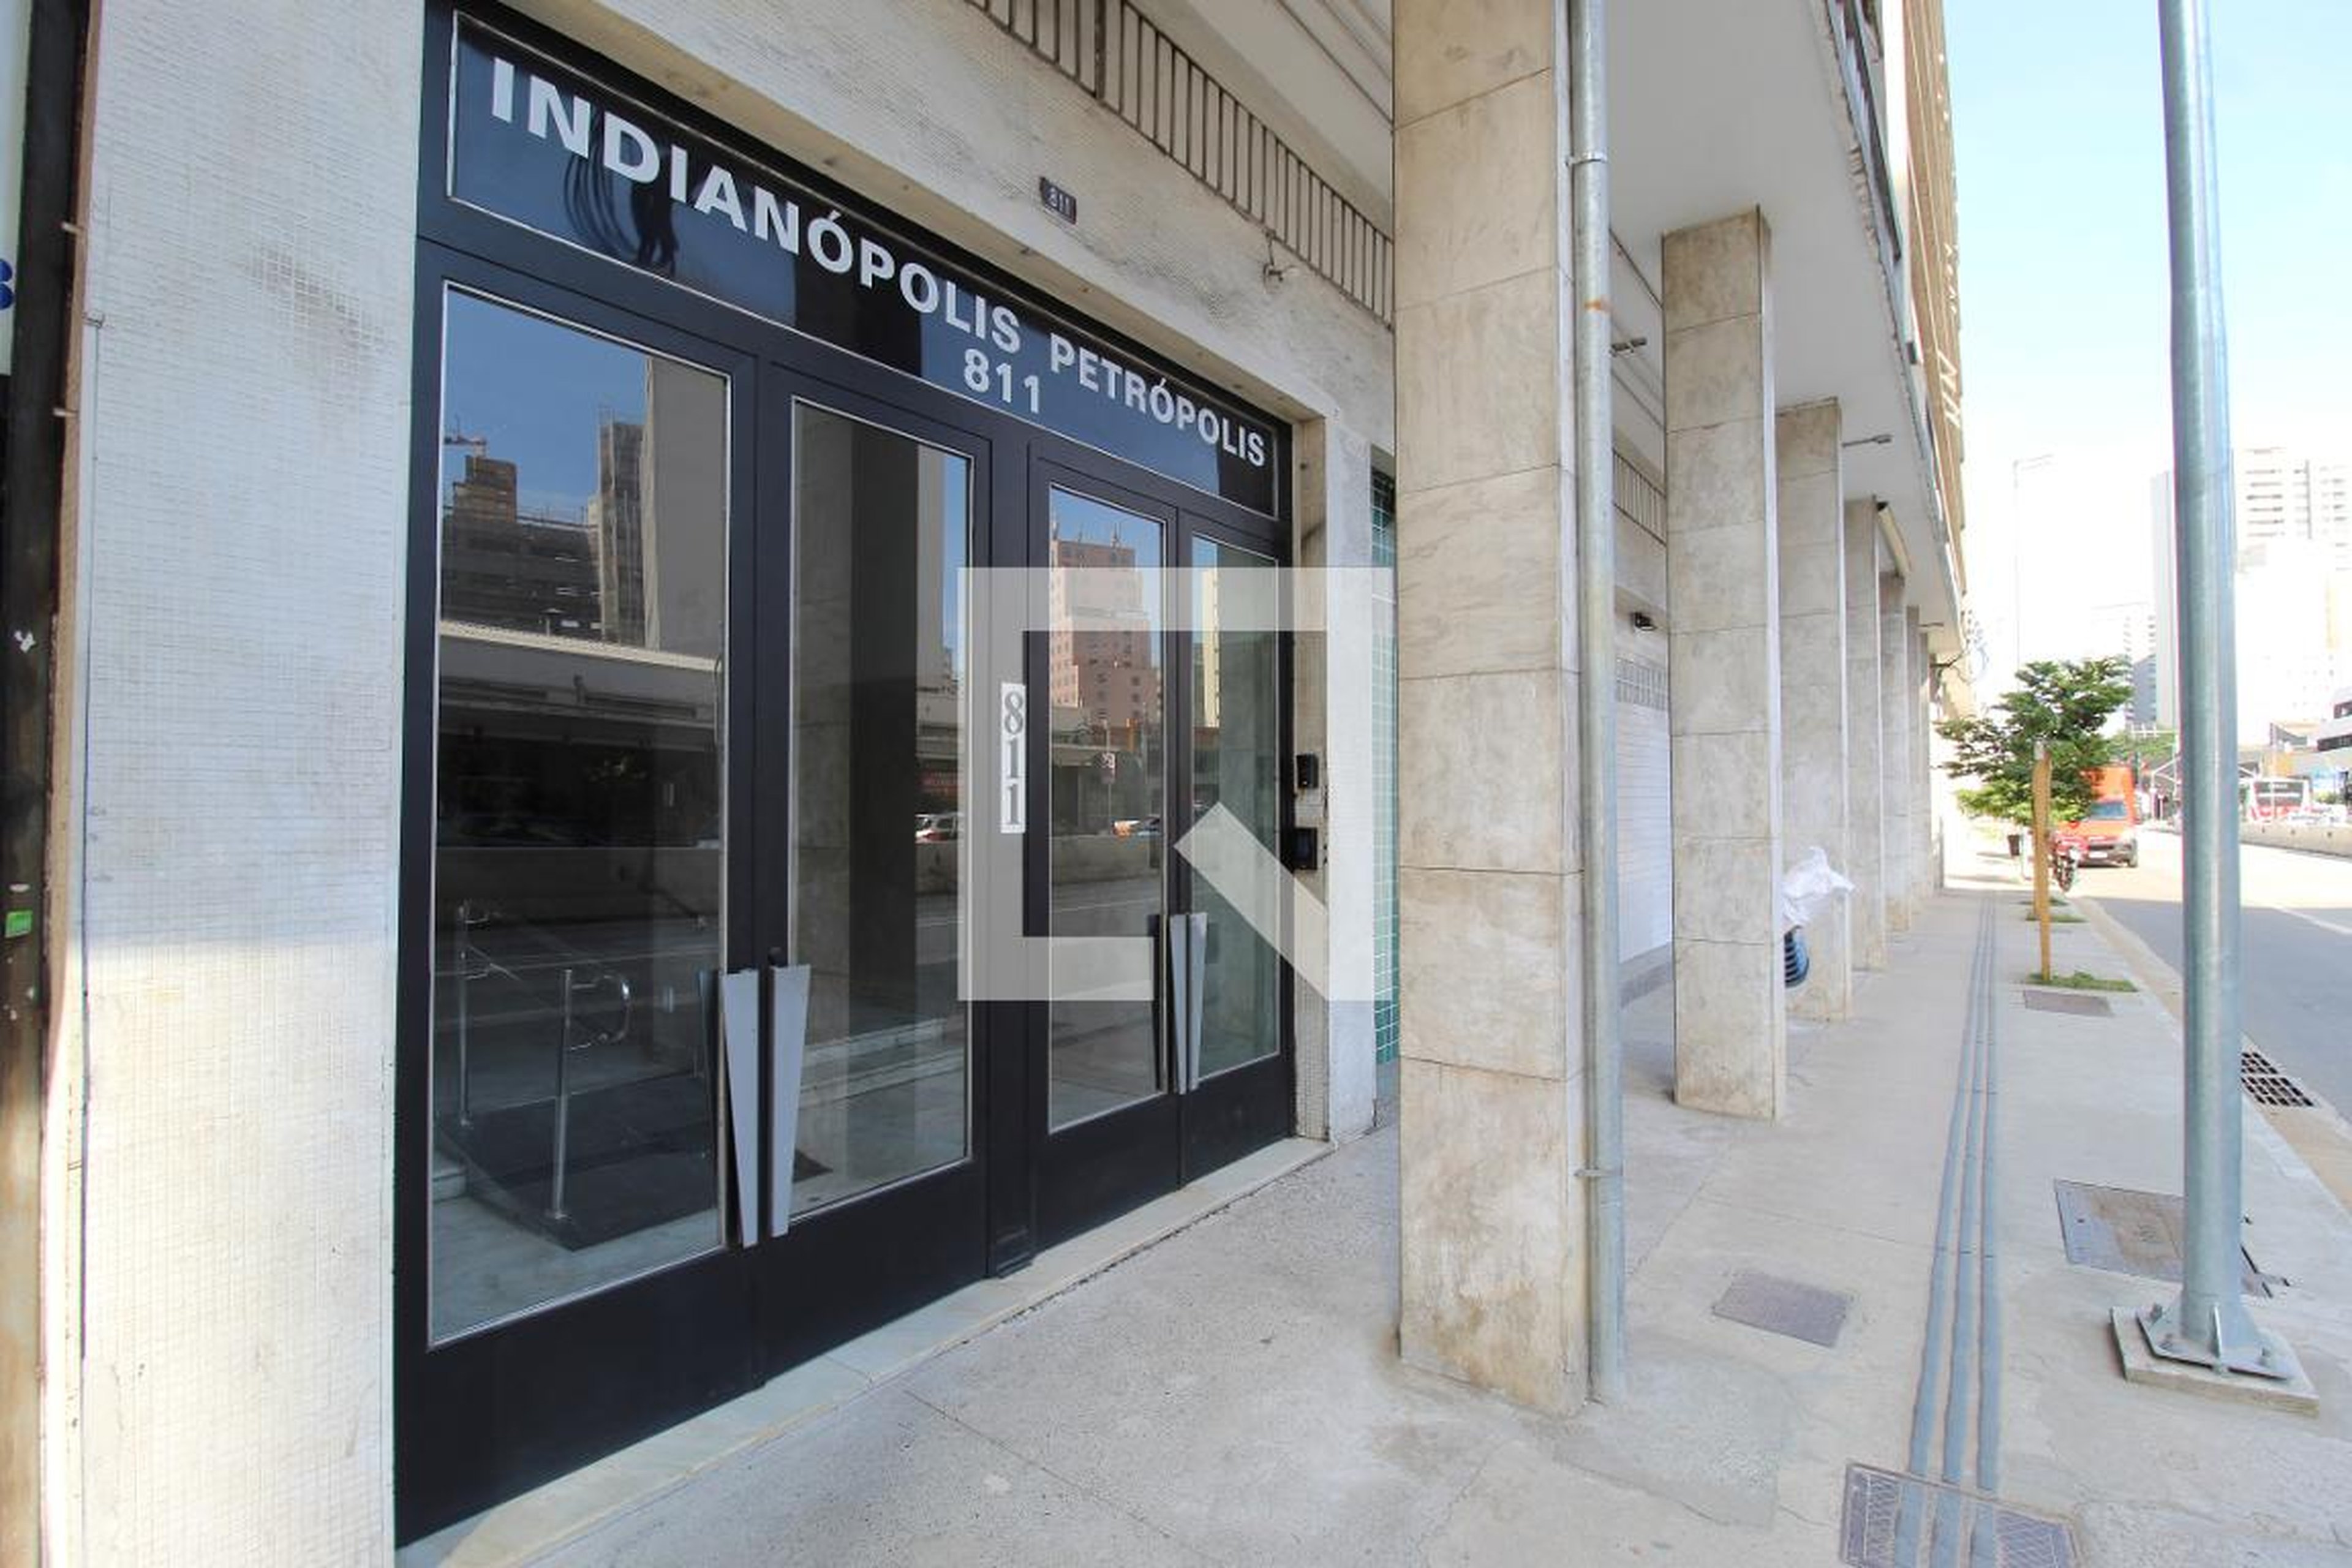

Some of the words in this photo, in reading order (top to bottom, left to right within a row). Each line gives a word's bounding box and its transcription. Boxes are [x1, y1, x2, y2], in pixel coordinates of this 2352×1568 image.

[492, 57, 1021, 353] INDIANÓPOLIS
[1050, 333, 1265, 467] PETRÓPOLIS
[964, 349, 1039, 414] 811
[1005, 692, 1023, 825] 811
